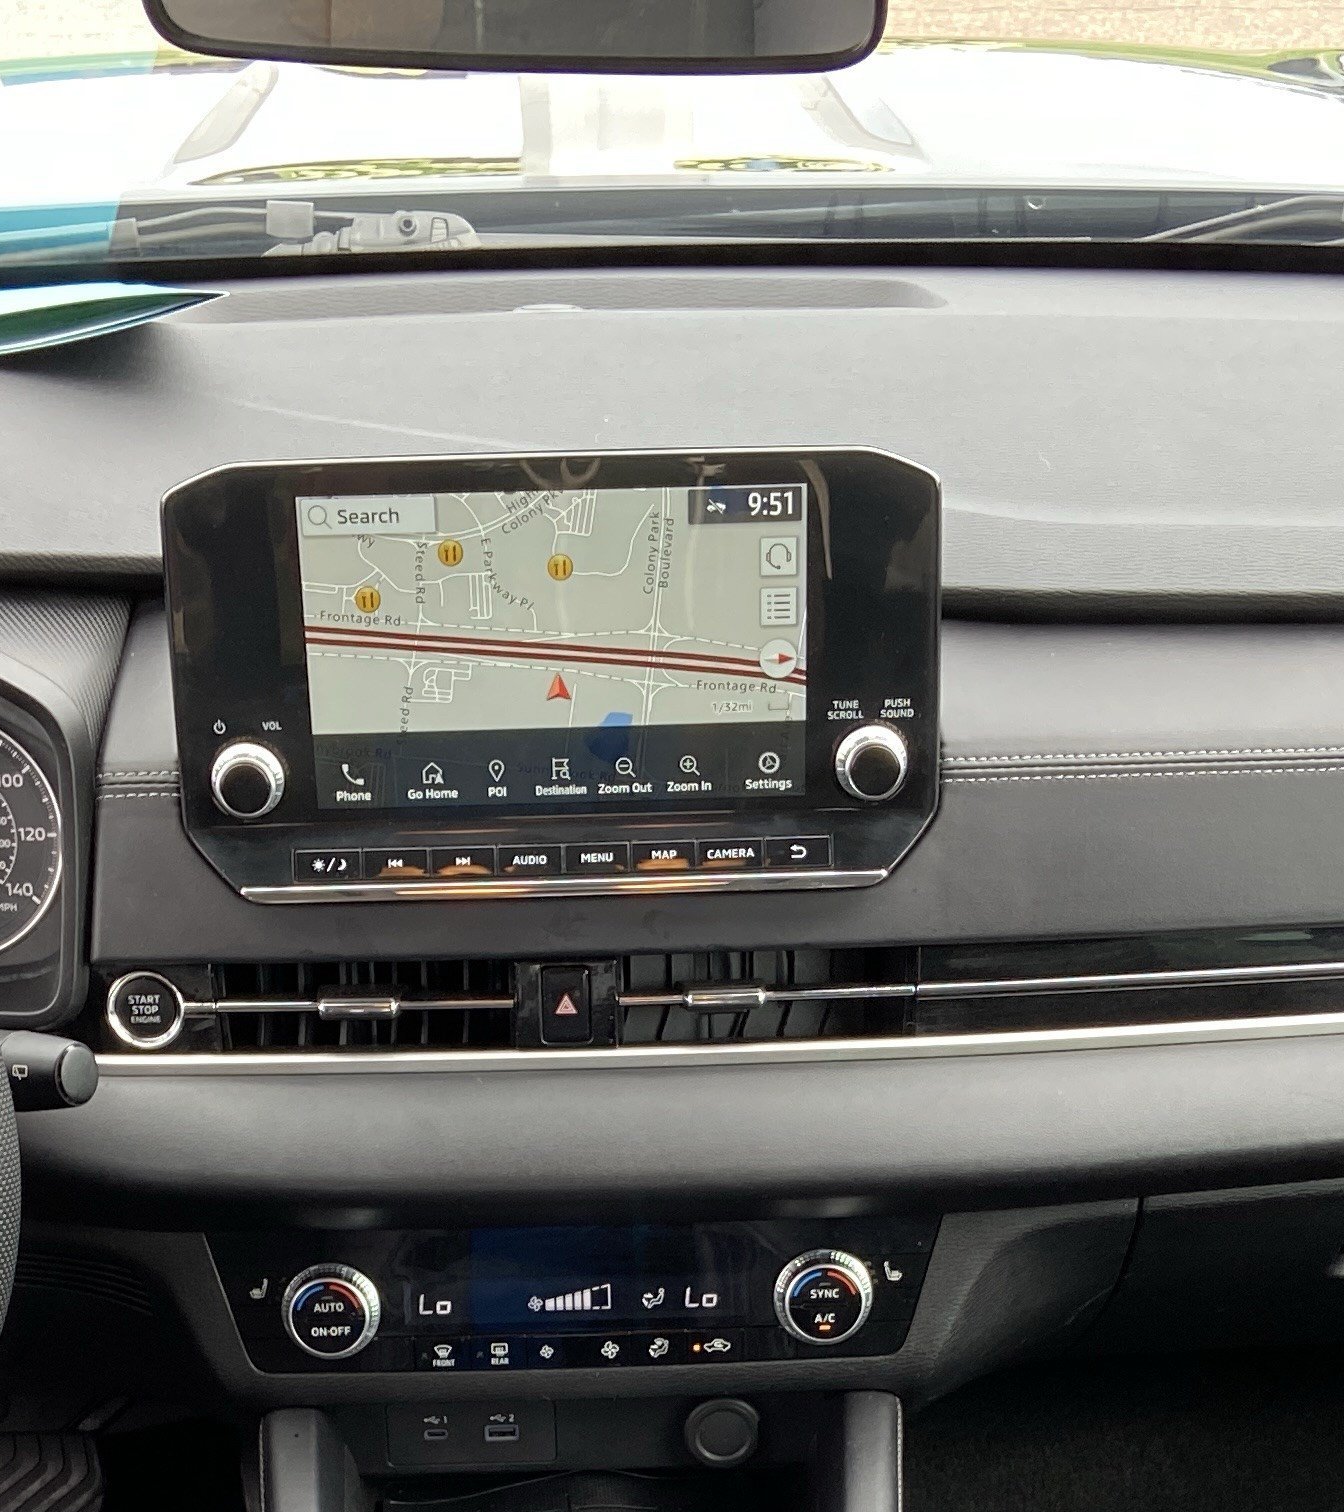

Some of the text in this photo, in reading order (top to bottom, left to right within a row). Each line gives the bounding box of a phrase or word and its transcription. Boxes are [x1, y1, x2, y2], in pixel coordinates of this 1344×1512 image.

[748, 492, 794, 516] 9:51
[337, 507, 400, 525] Search
[501, 505, 543, 534] Colony
[643, 511, 660, 594] Colony Park
[658, 518, 674, 588] Boulevard
[415, 542, 428, 604] Steed Rd
[483, 551, 518, 605] Parkway
[320, 610, 401, 627] Frontage Rd
[696, 679, 777, 694] Frontage Rd
[401, 686, 413, 703] Rd
[712, 701, 753, 714] 1/32mi
[832, 700, 859, 710] TUNE
[884, 699, 910, 708] PUSH
[827, 710, 864, 720] SCROLL
[880, 708, 914, 718] SOUND
[261, 721, 282, 731] VOL
[598, 782, 652, 793] Zoom Out
[666, 781, 698, 792] Zoom
[701, 780, 712, 791] In
[745, 777, 792, 791] Settings
[336, 790, 372, 801] Phone
[408, 788, 458, 800] Go Home
[487, 787, 507, 797] POI
[535, 784, 587, 796] Destination
[17, 827, 46, 842] 120
[580, 853, 614, 863] MENU
[651, 850, 677, 860] MAP
[706, 848, 755, 859] CAMERA
[512, 855, 547, 865] AUDIO
[6, 882, 34, 897] 140
[127, 994, 160, 1005] START
[131, 1005, 159, 1015] STOP
[684, 1286, 718, 1308] Lo
[810, 1288, 840, 1299] SYNC
[313, 1302, 345, 1313] AUTO
[419, 1293, 452, 1315] Lo
[814, 1313, 836, 1324] A/C
[432, 1358, 455, 1367] FRONT
[490, 1357, 509, 1365] REAR
